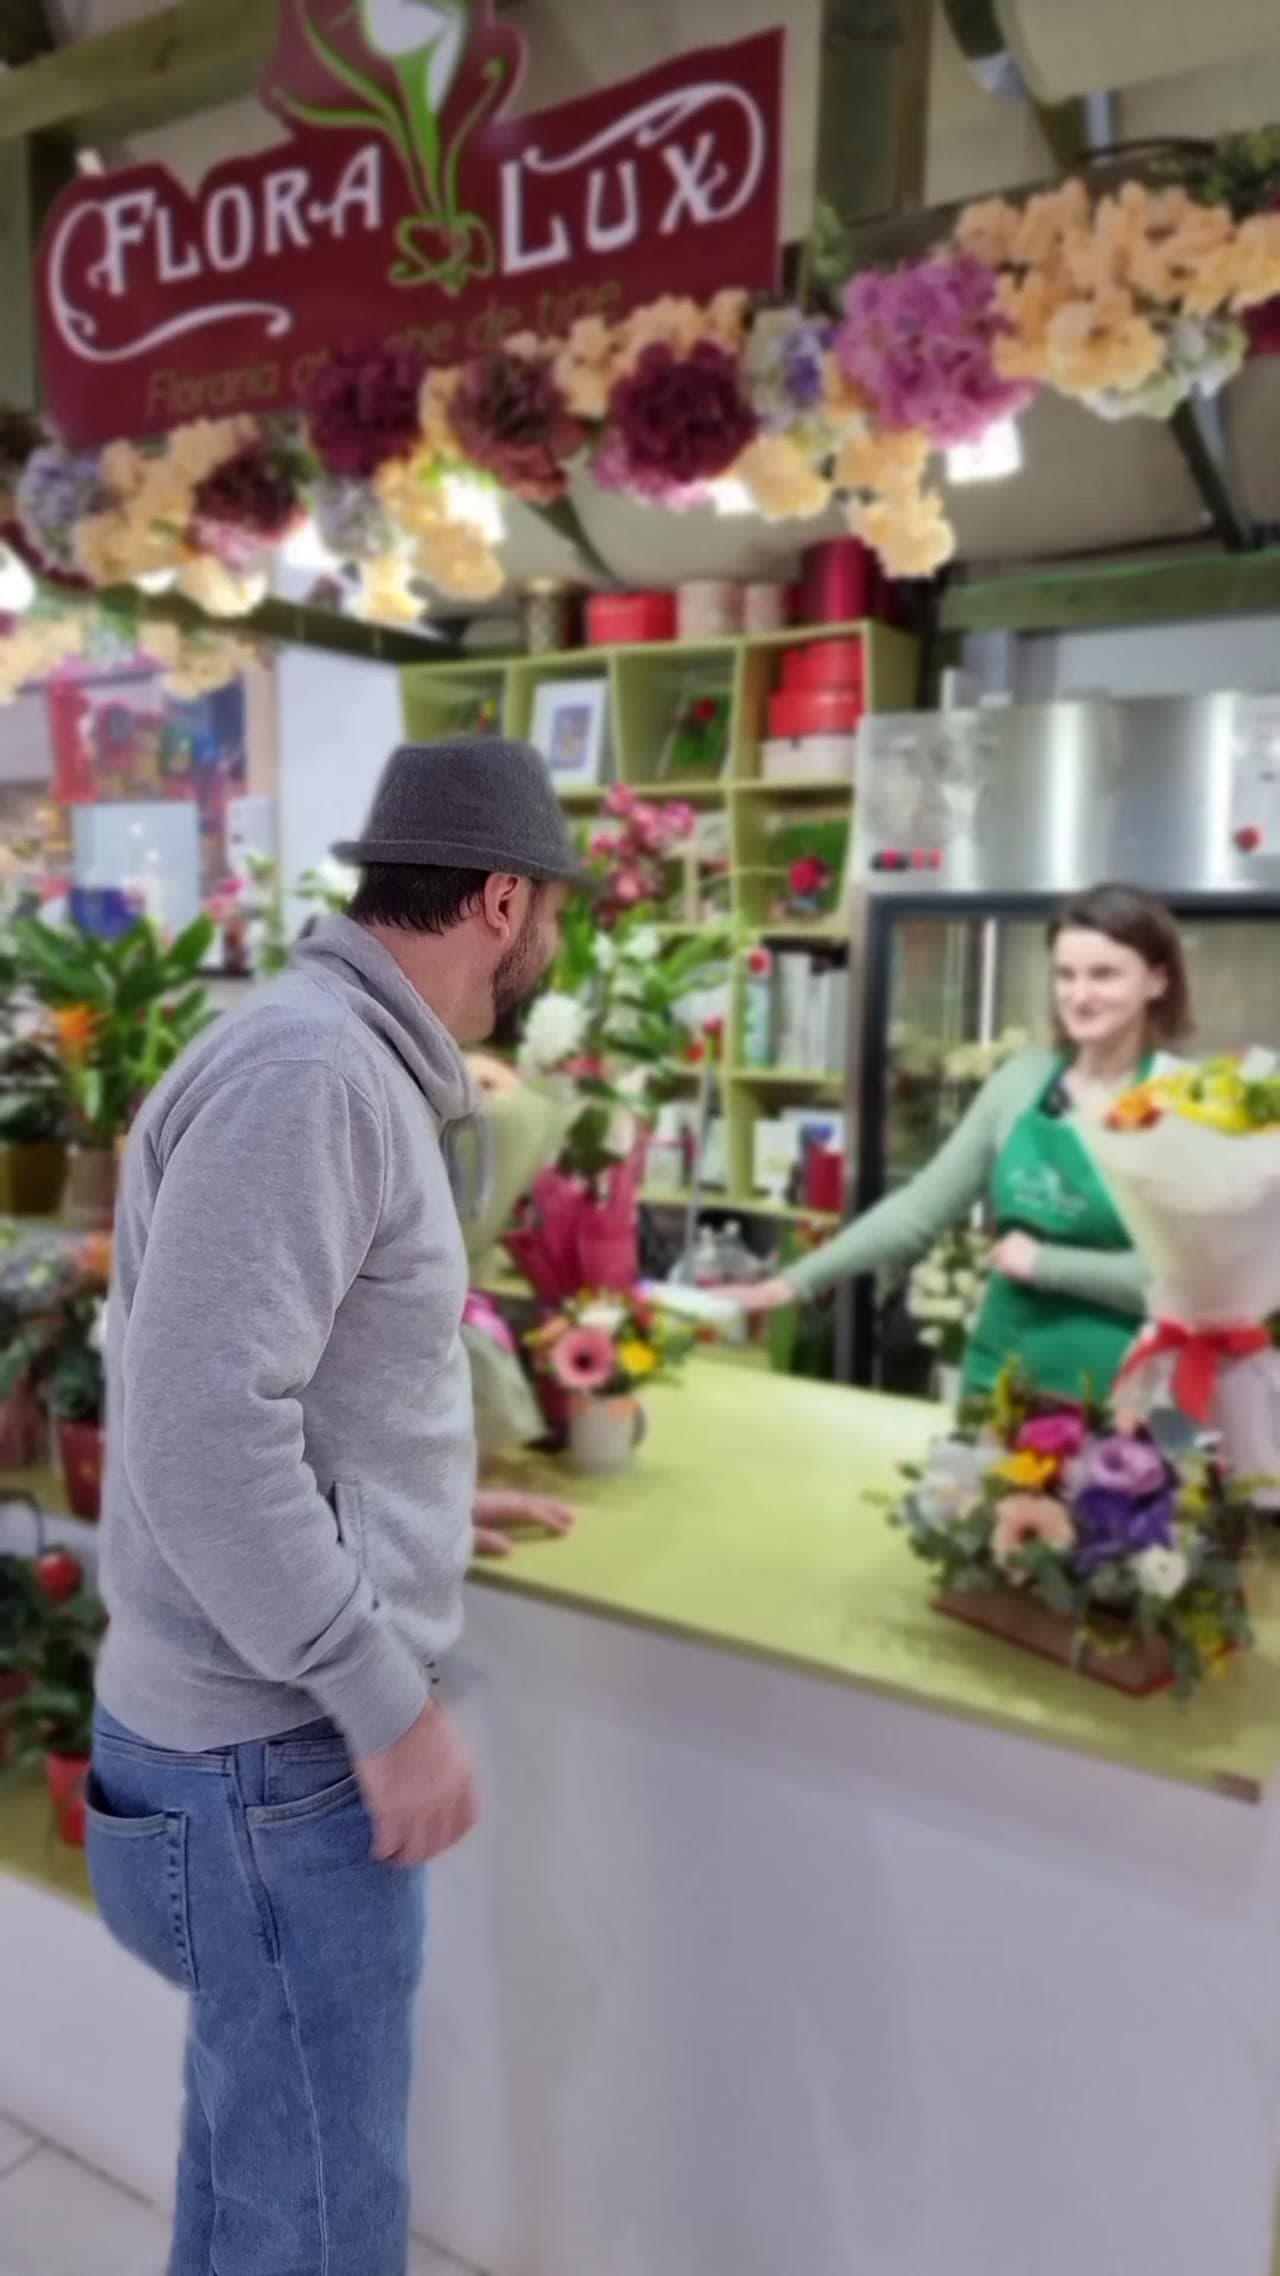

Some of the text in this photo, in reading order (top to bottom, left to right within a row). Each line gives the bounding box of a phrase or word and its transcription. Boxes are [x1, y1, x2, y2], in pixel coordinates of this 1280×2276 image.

[85, 131, 730, 297] FLORA LUX
[465, 296, 524, 352] de
